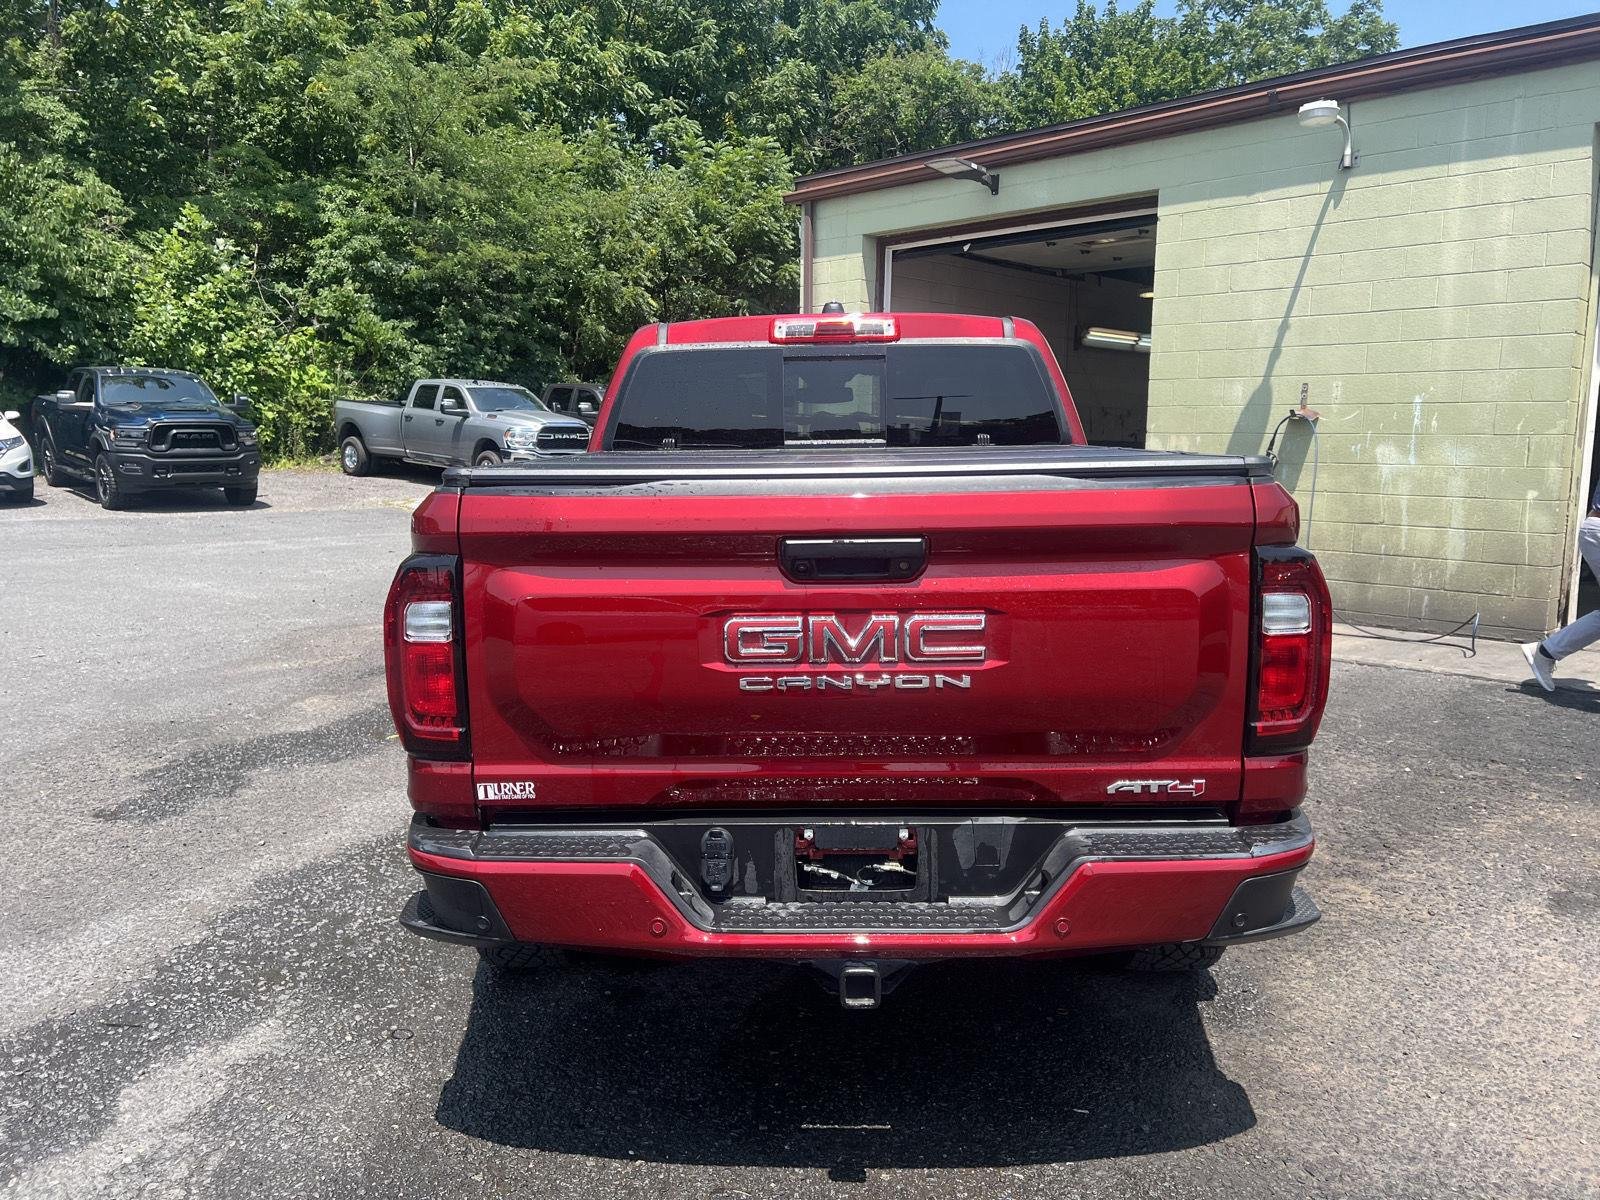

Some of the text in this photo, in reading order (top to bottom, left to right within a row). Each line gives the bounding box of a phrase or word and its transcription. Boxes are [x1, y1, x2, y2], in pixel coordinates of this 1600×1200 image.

[723, 614, 987, 664] GMC
[739, 674, 971, 692] CANYON
[477, 782, 535, 800] TURNER
[1107, 779, 1205, 796] AT4
